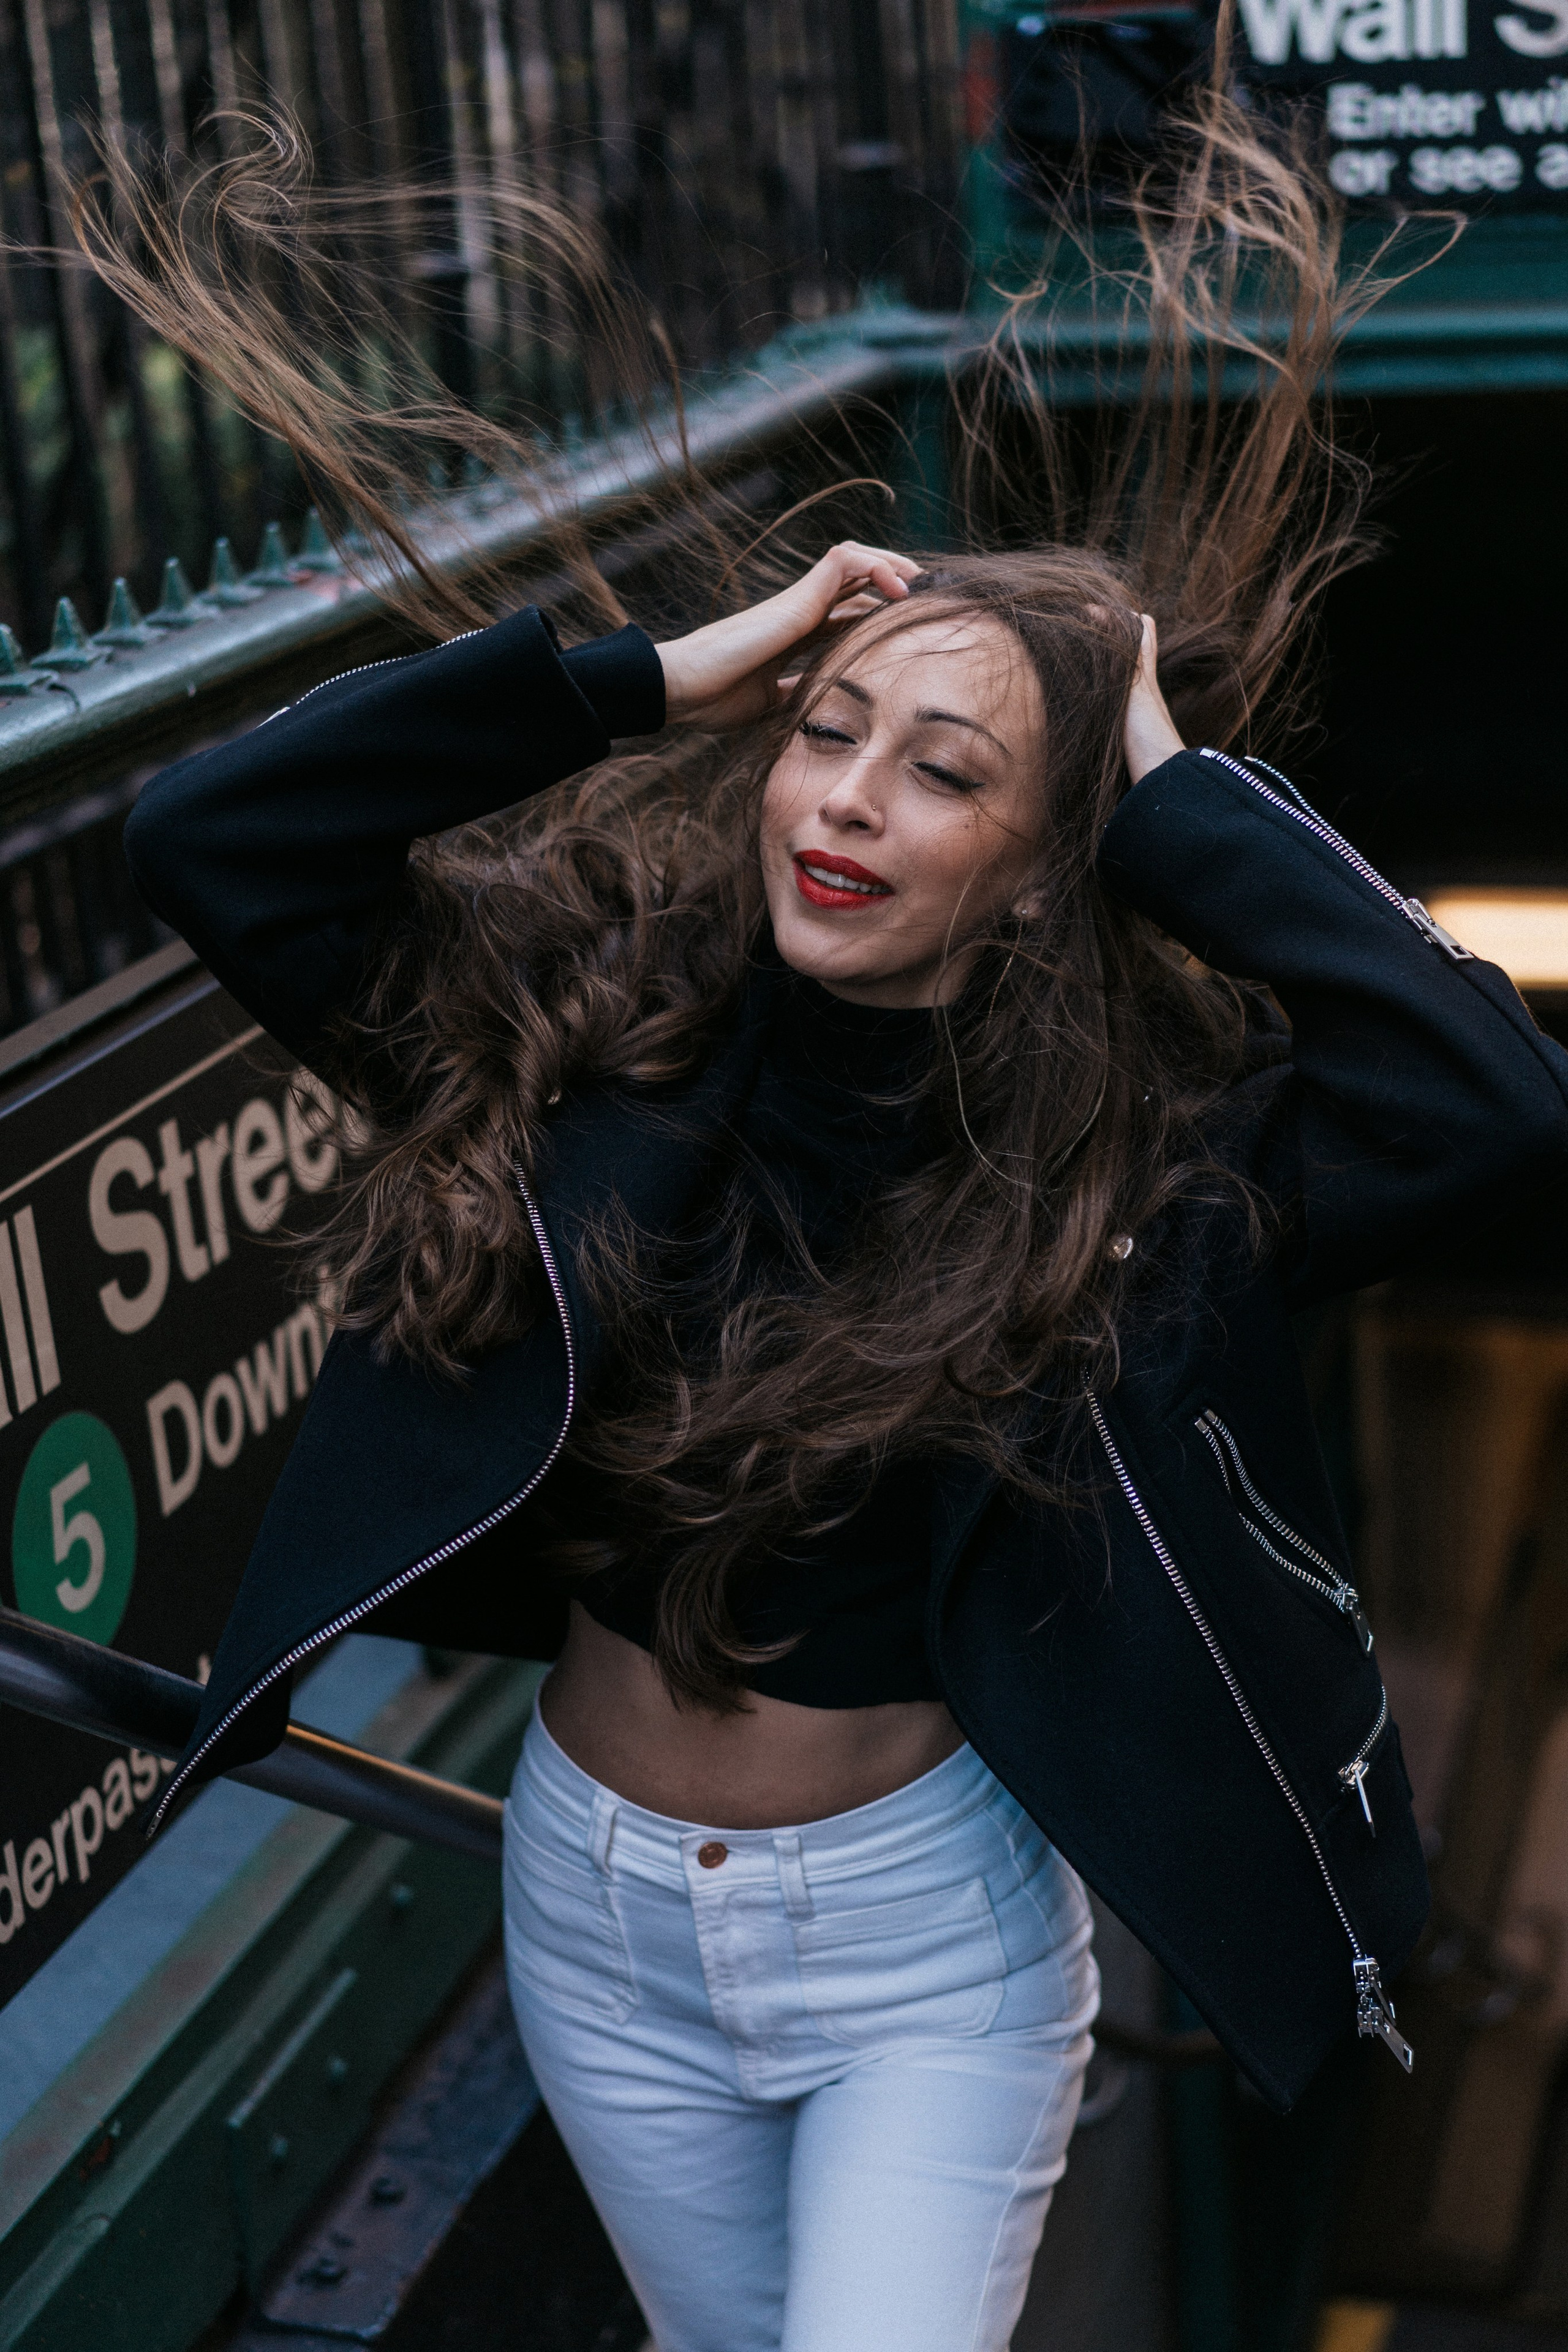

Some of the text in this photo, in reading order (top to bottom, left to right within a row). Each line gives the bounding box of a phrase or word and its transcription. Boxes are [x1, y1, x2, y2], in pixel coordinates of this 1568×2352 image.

[1237, 0, 1469, 64] Wall
[1327, 81, 1485, 140] Enter
[1328, 145, 1398, 196] or
[1409, 143, 1523, 193] see
[50, 1462, 105, 1613] 5
[0, 1747, 178, 1943] derpas
